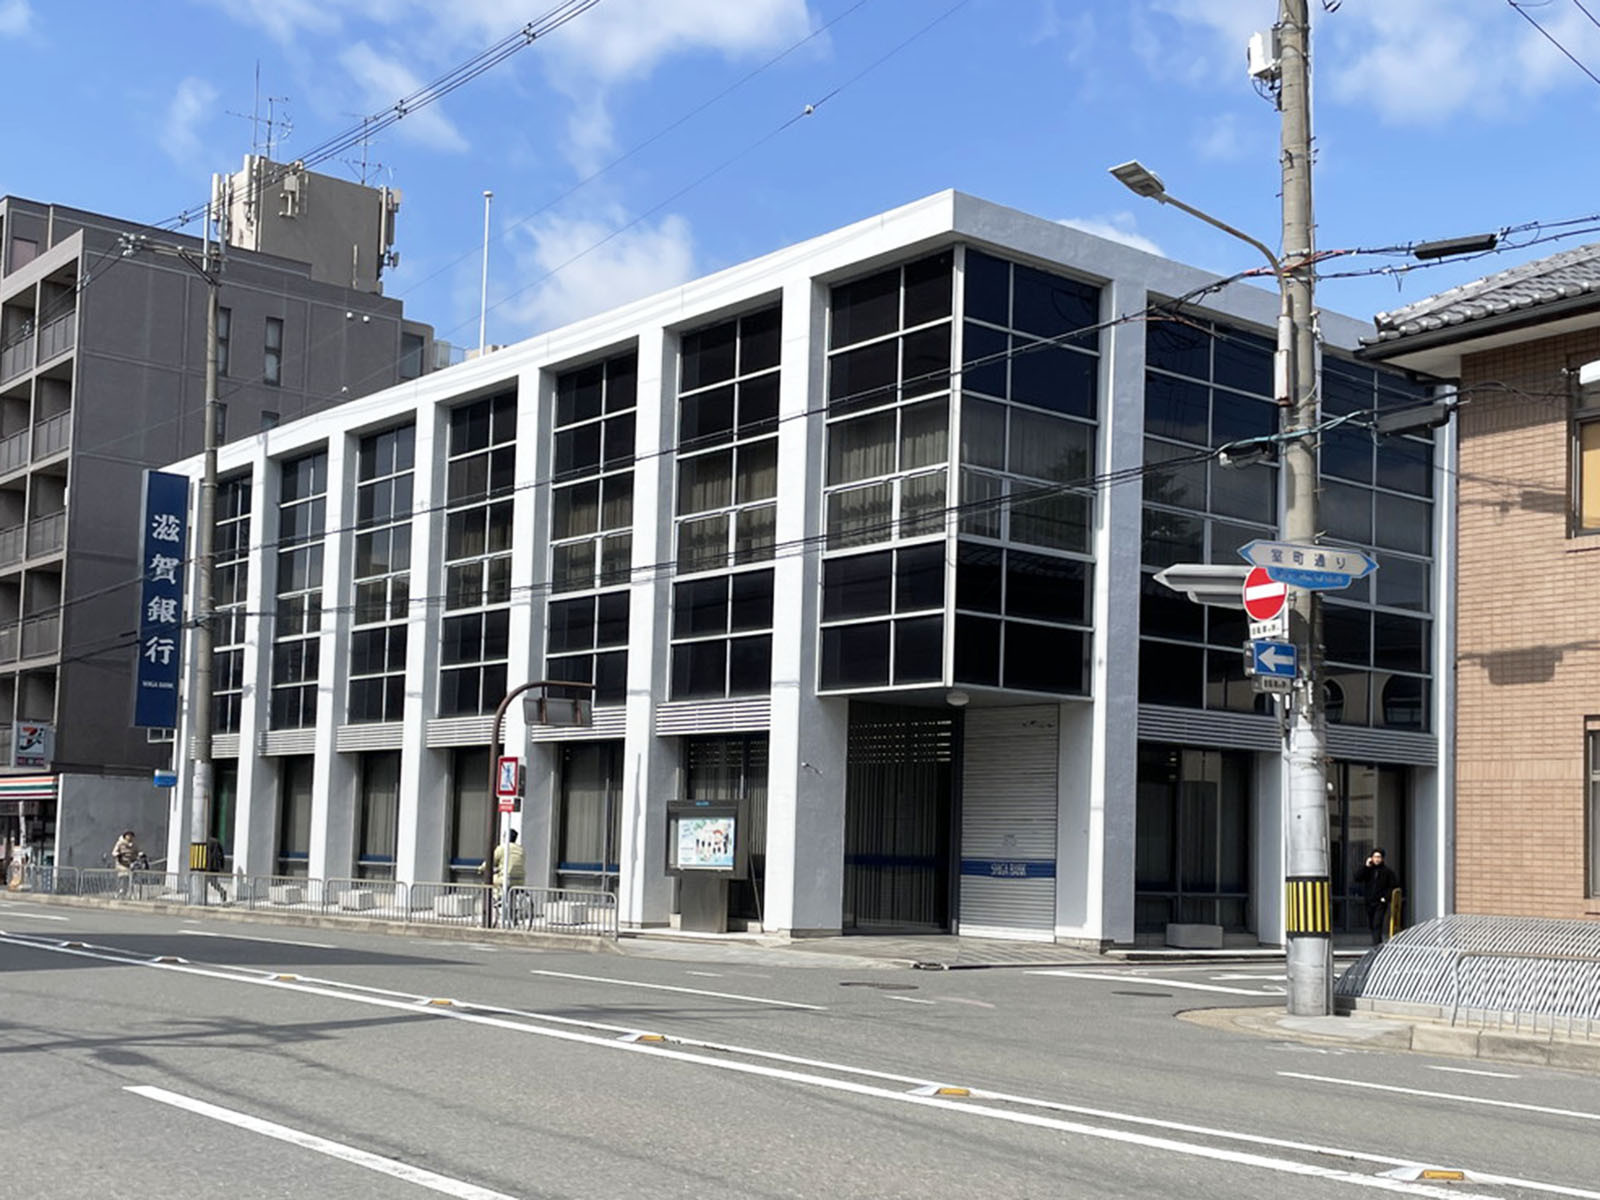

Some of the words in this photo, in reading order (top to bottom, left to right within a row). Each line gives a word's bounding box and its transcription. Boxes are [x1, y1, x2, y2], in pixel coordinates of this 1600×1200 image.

[145, 514, 180, 665] 滋賀銀行
[1271, 548, 1346, 569] 室町通り
